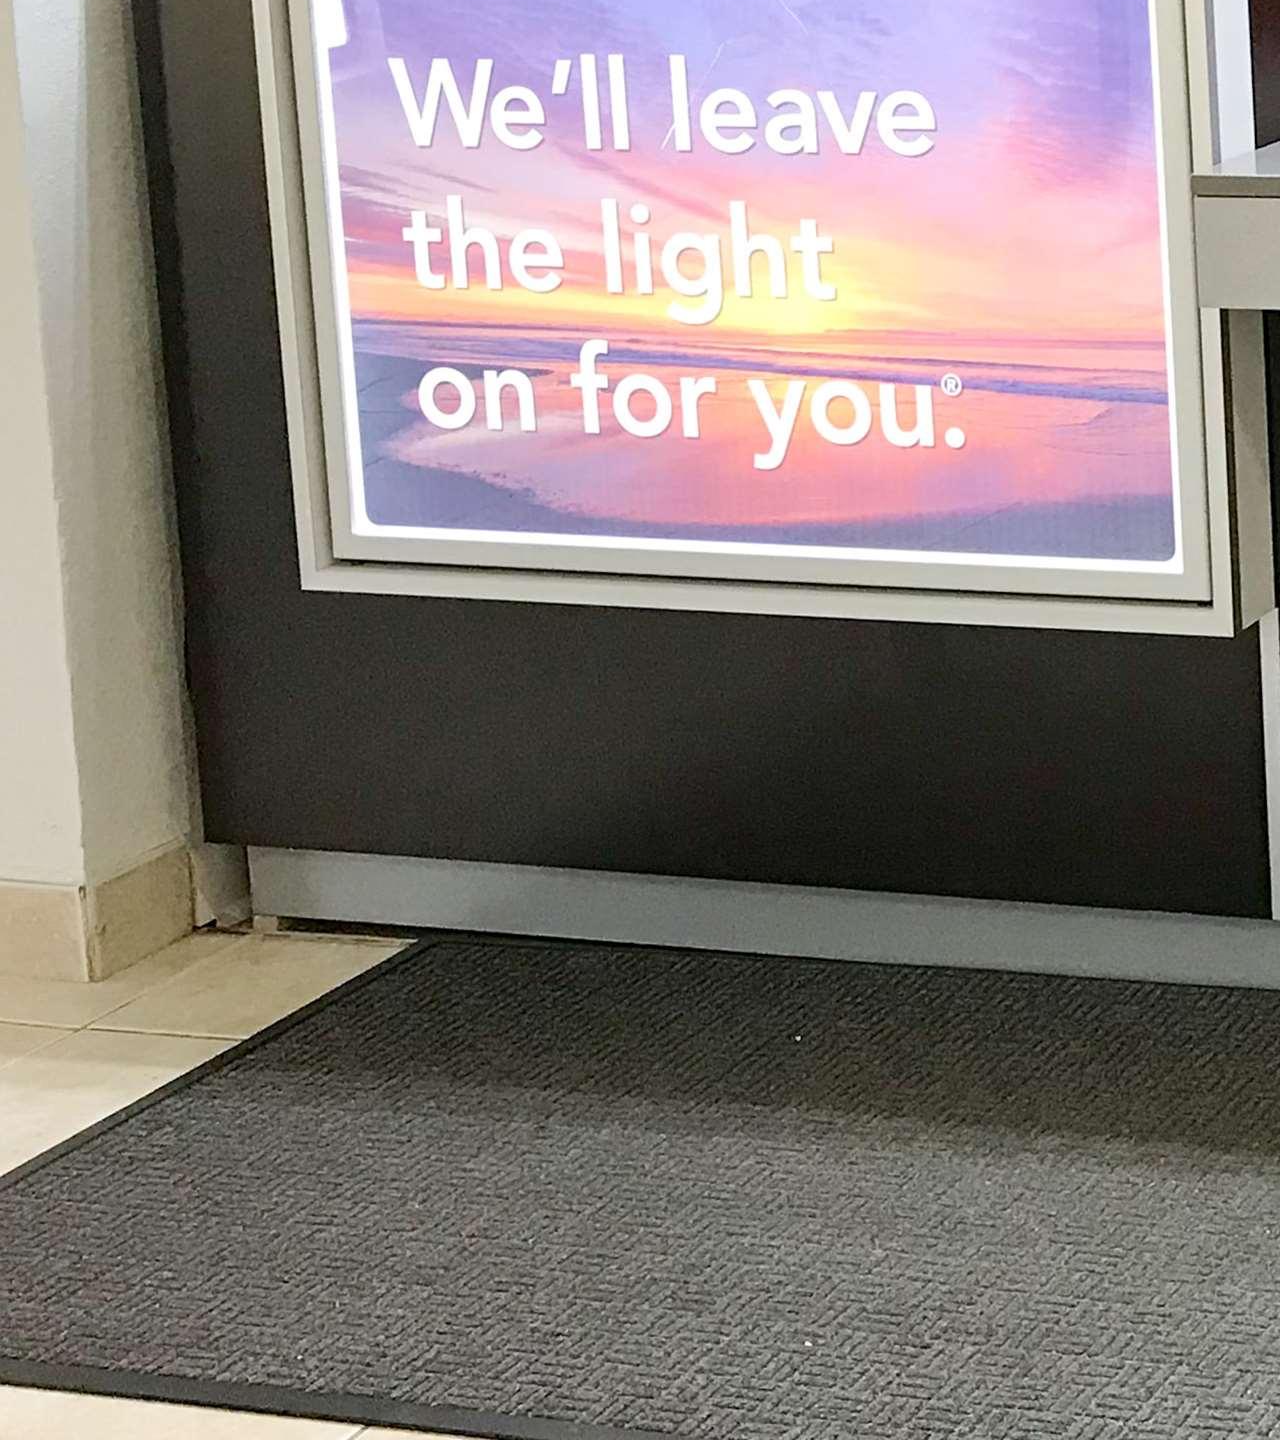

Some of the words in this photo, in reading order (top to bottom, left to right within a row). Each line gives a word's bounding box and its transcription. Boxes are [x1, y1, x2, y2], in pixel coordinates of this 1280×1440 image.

[388, 53, 631, 151] We'll
[669, 53, 936, 157] leave
[402, 195, 564, 294] the
[602, 197, 837, 325] light
[417, 363, 537, 433] on
[570, 340, 717, 439] for
